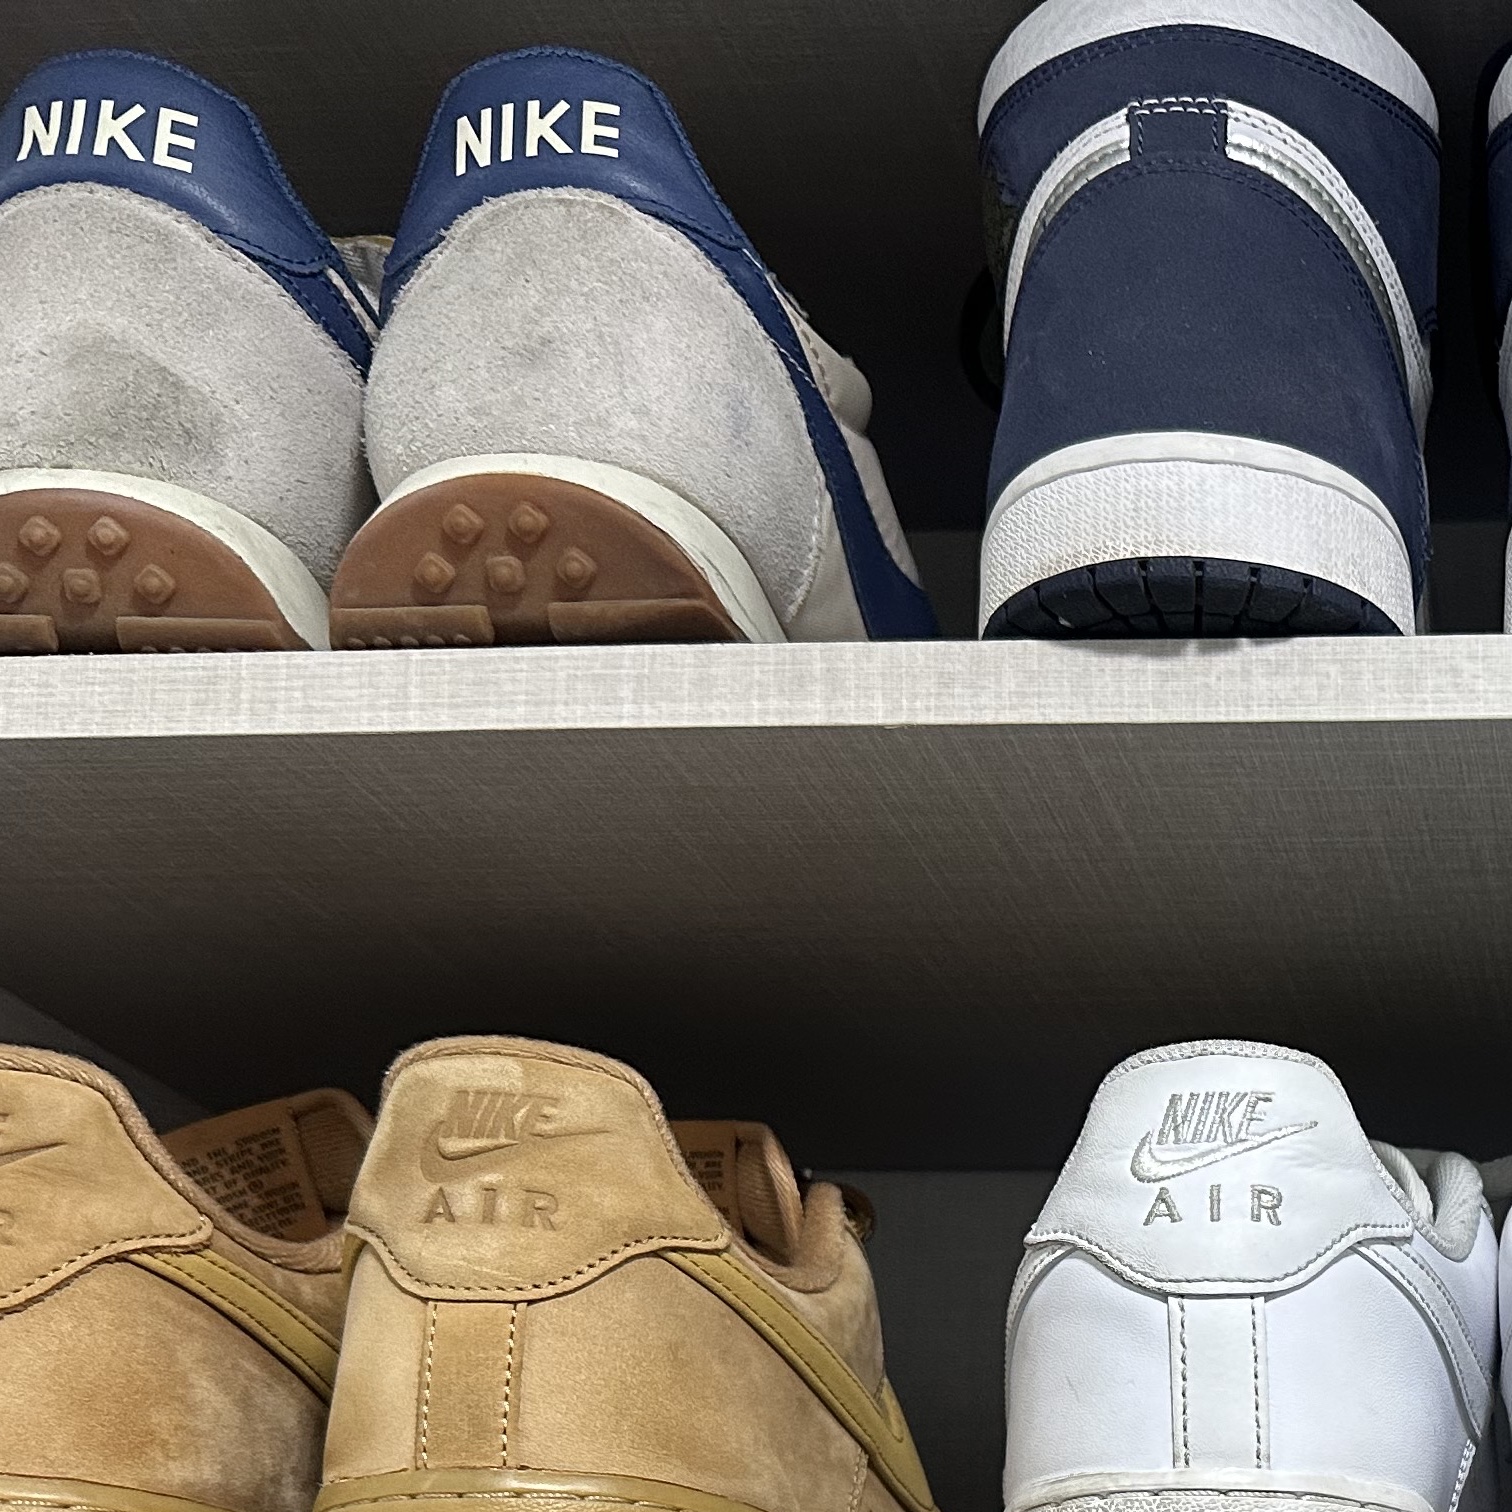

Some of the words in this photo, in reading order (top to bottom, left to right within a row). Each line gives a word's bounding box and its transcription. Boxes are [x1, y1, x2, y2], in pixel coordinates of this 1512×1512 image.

[17, 97, 199, 173] NIKE
[454, 99, 622, 176] NIKE
[443, 1089, 562, 1139] NIKE
[1156, 1090, 1277, 1145] NIKE
[418, 1186, 559, 1232] AIR
[1142, 1183, 1284, 1227] AIR
